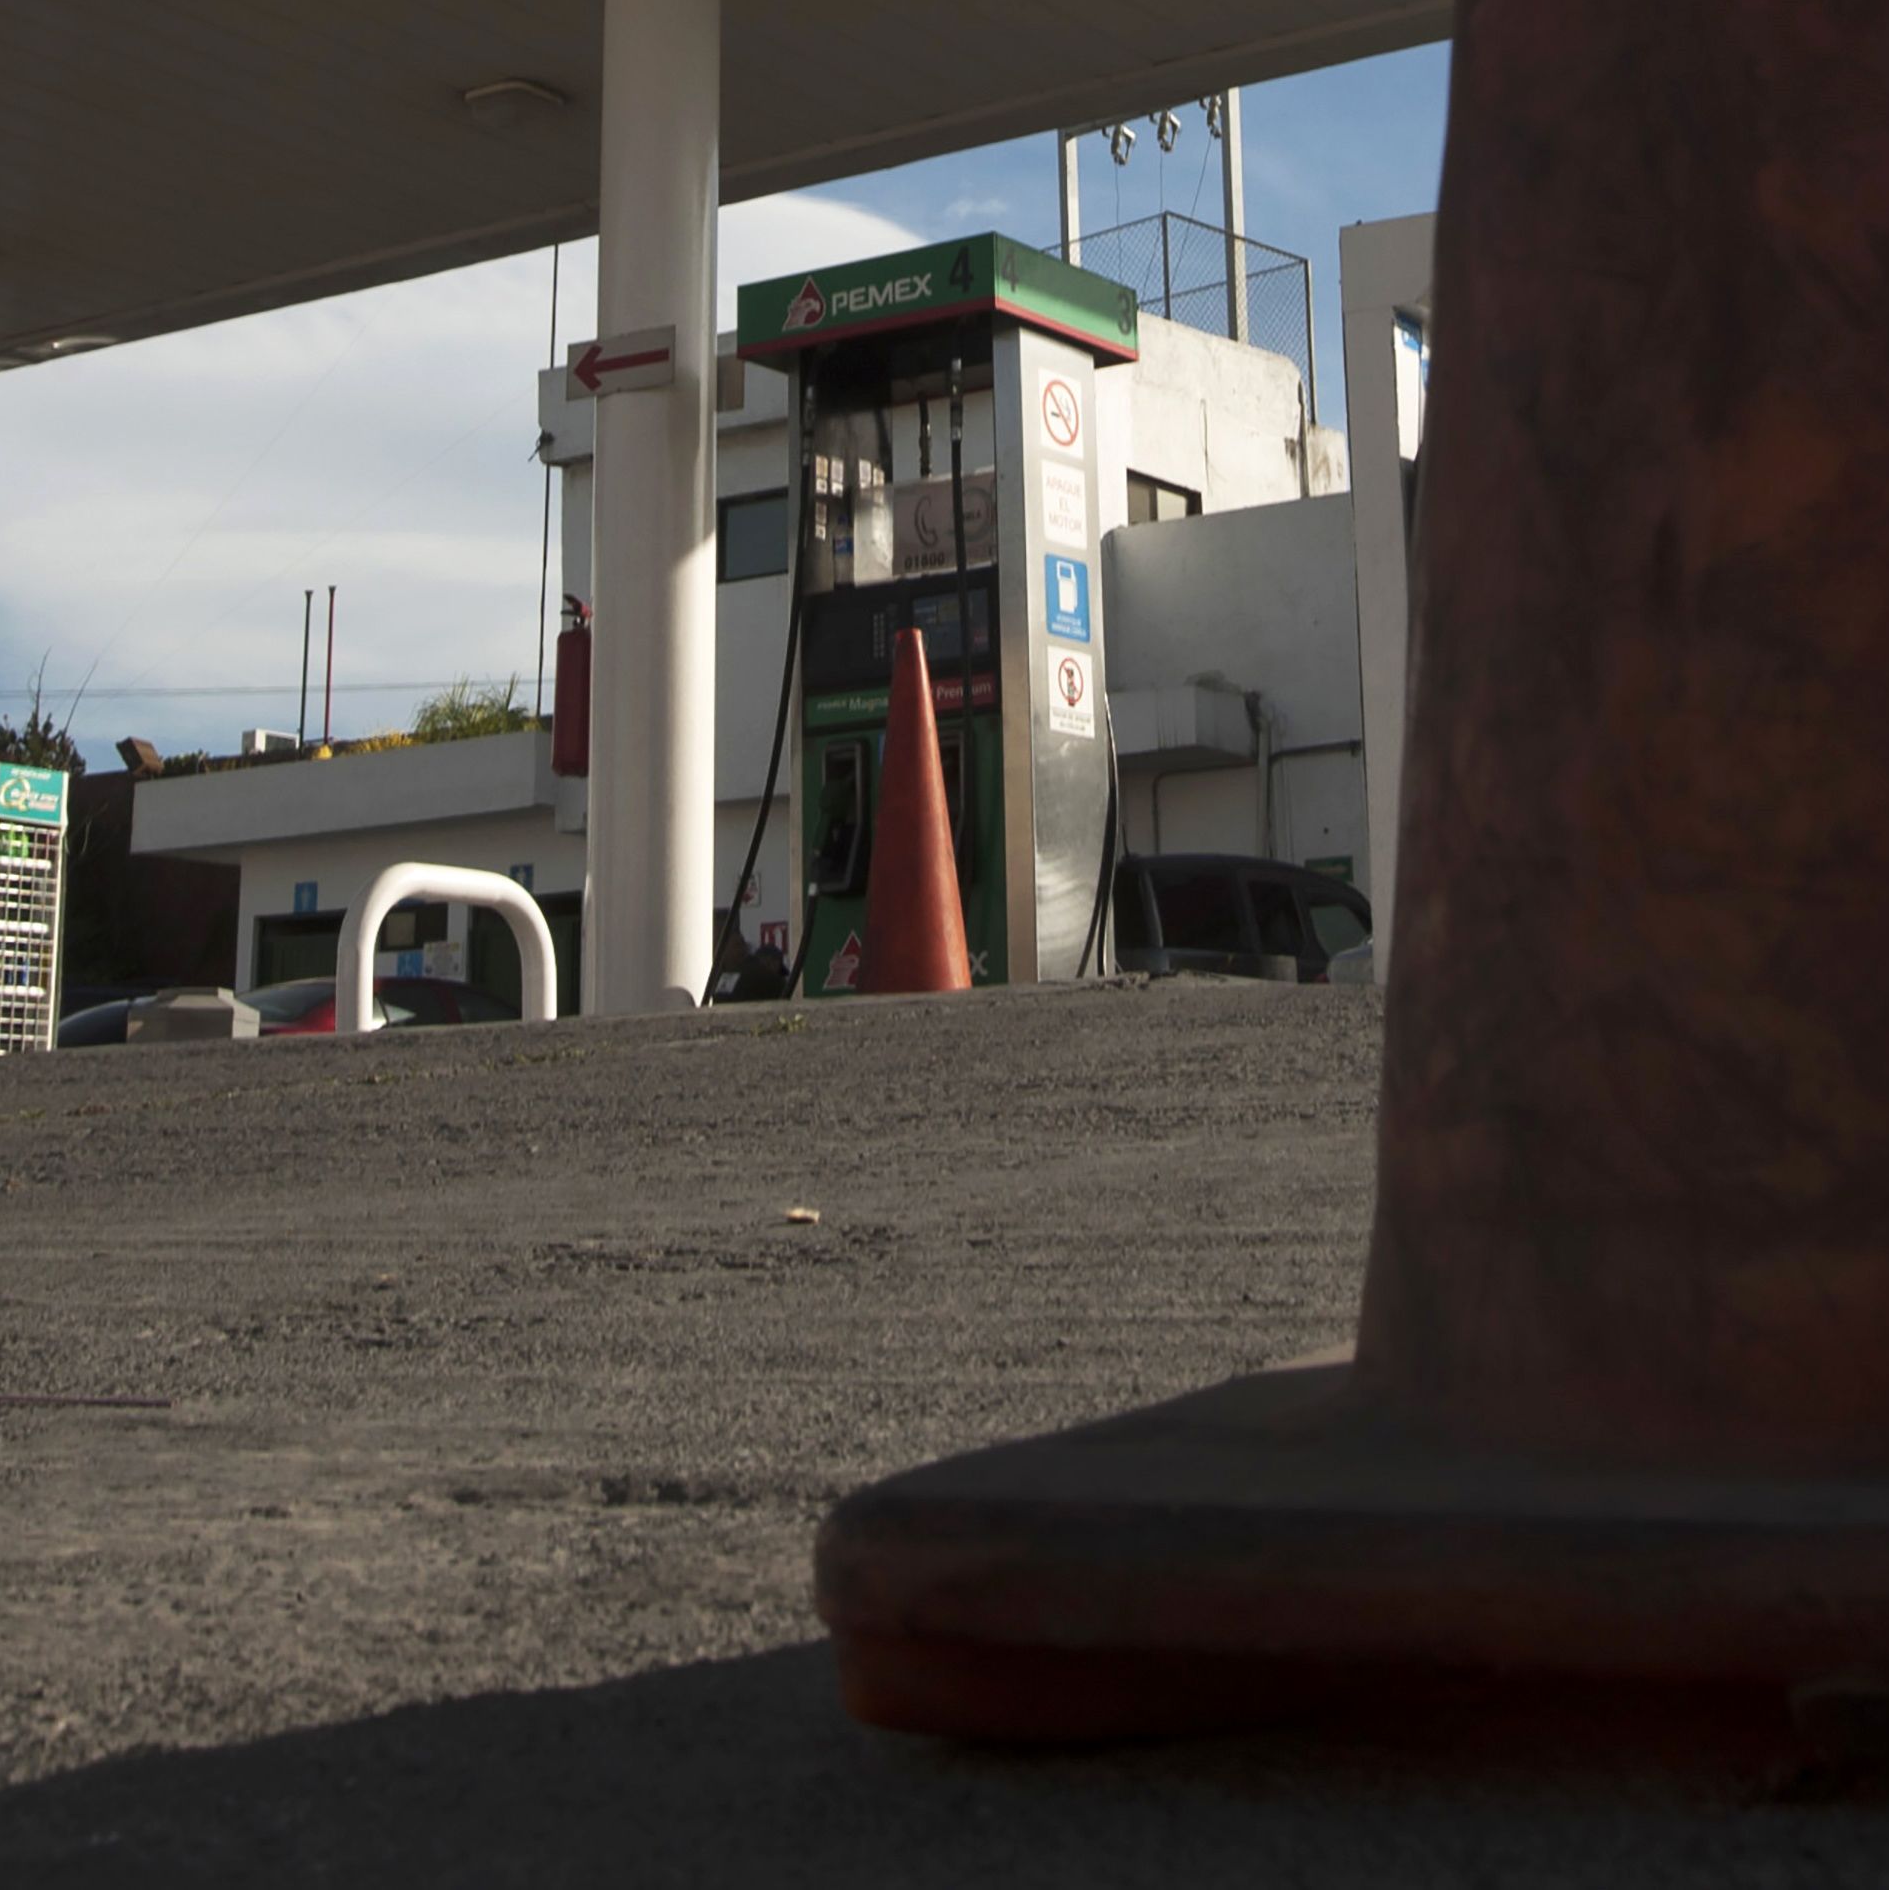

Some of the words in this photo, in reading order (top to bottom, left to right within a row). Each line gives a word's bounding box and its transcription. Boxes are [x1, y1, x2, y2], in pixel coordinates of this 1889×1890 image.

[831, 273, 932, 316] PEMEX
[949, 245, 974, 294] 4
[1001, 251, 1020, 292] 4
[1117, 292, 1132, 336] 3
